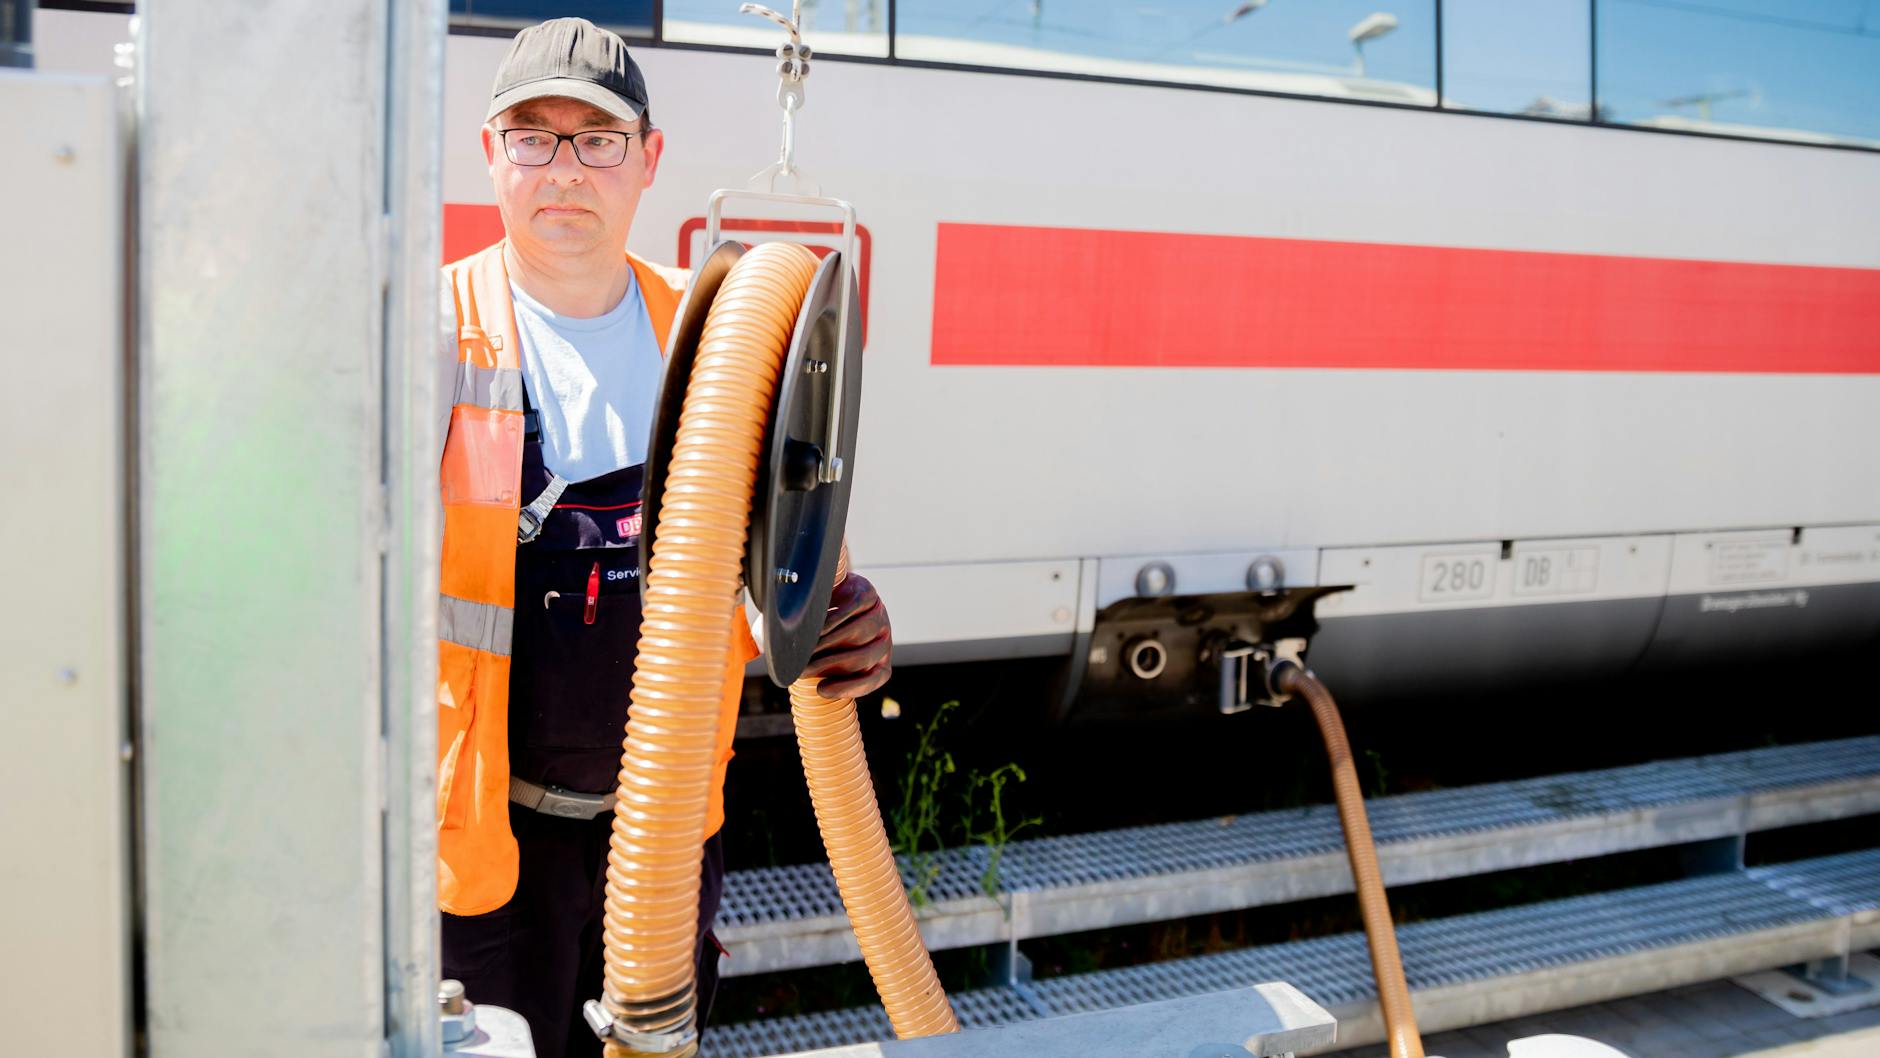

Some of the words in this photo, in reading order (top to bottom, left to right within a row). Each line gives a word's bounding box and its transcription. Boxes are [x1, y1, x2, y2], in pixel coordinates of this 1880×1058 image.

[607, 567, 641, 581] Servi
[1431, 559, 1485, 593] 280
[1523, 555, 1552, 587] DB
